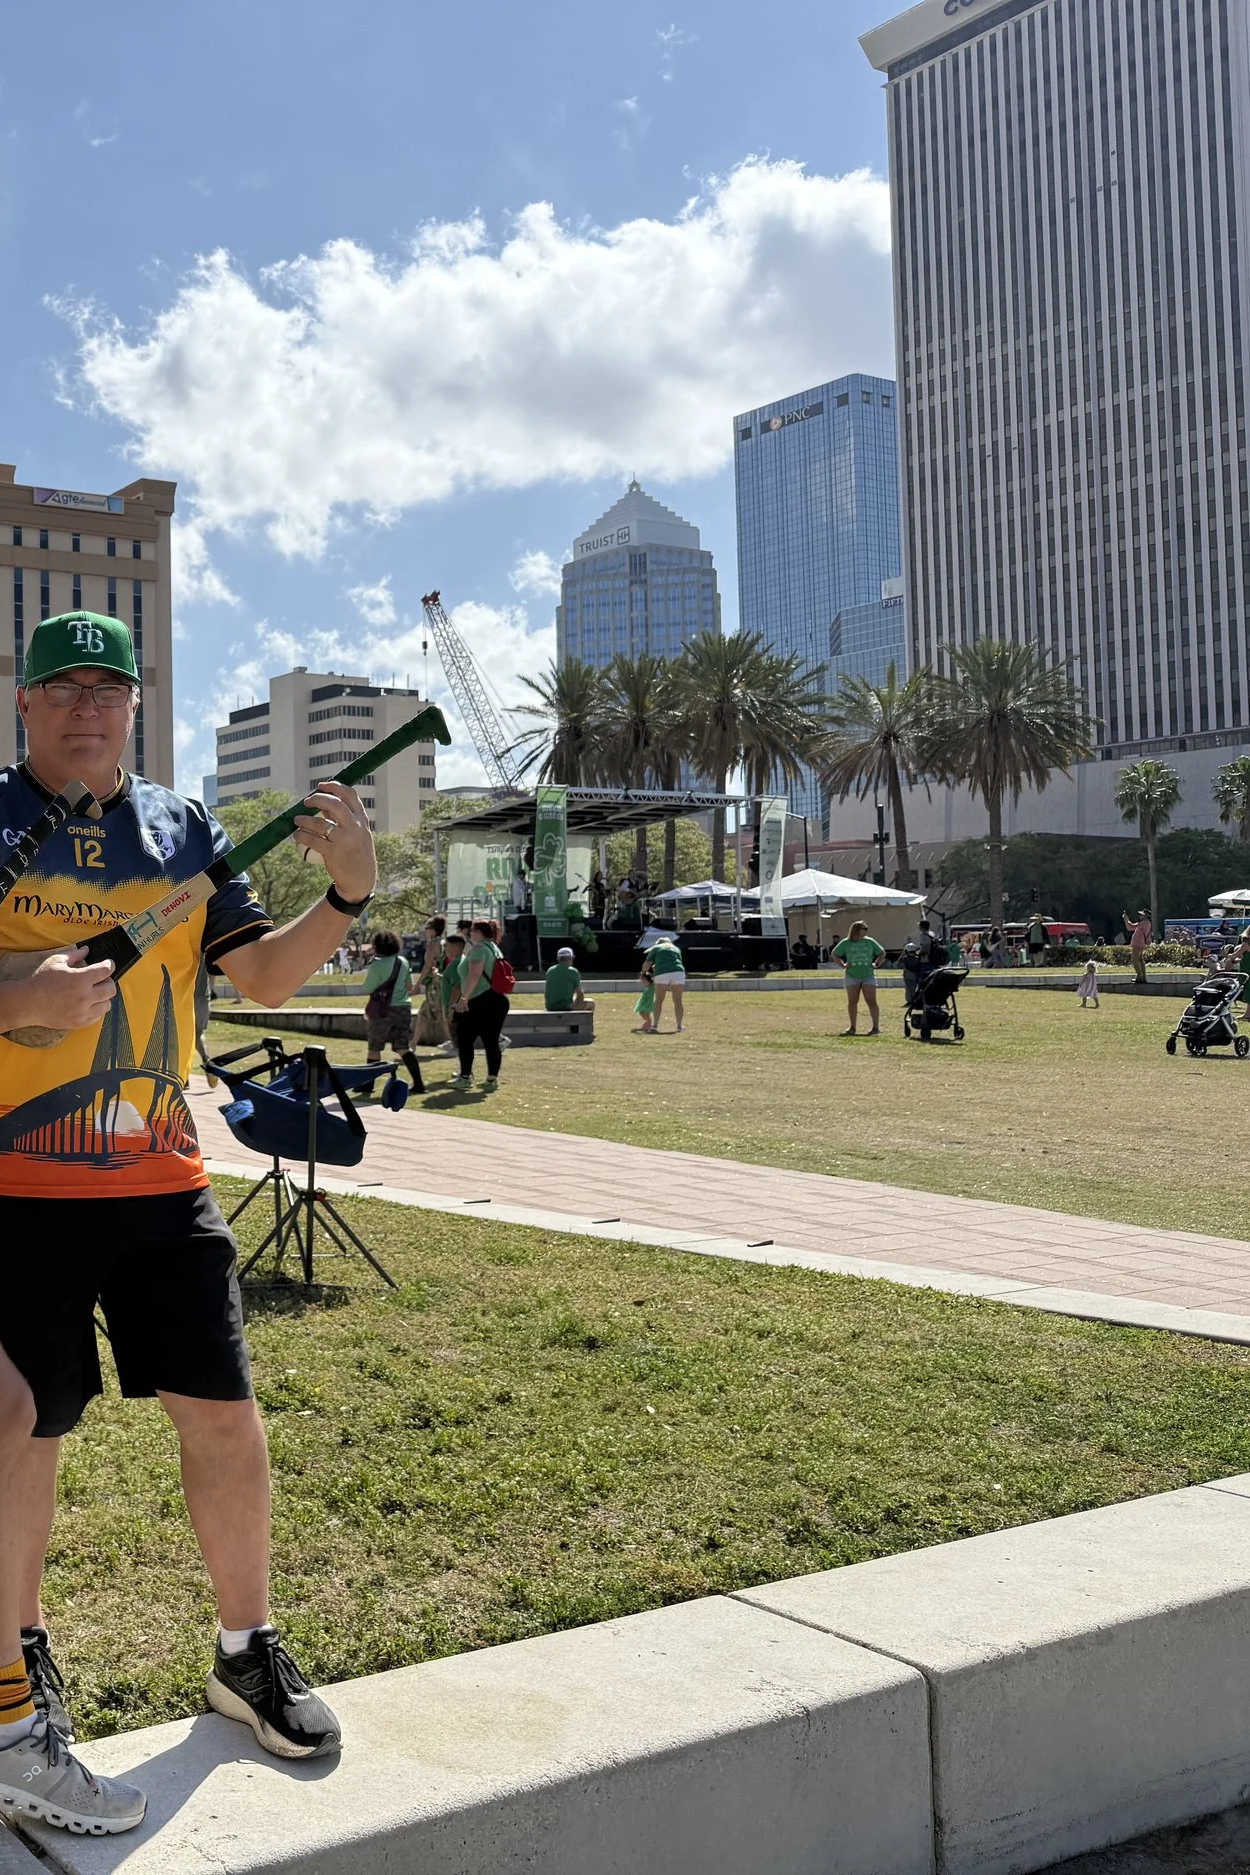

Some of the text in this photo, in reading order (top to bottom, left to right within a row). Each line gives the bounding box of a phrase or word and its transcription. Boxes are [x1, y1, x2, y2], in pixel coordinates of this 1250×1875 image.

[785, 406, 811, 425] PNC
[61, 493, 79, 506] gte
[579, 534, 615, 554] TRUIST
[67, 621, 105, 653] TB
[74, 838, 106, 868] 12
[161, 891, 192, 918] DENOVI
